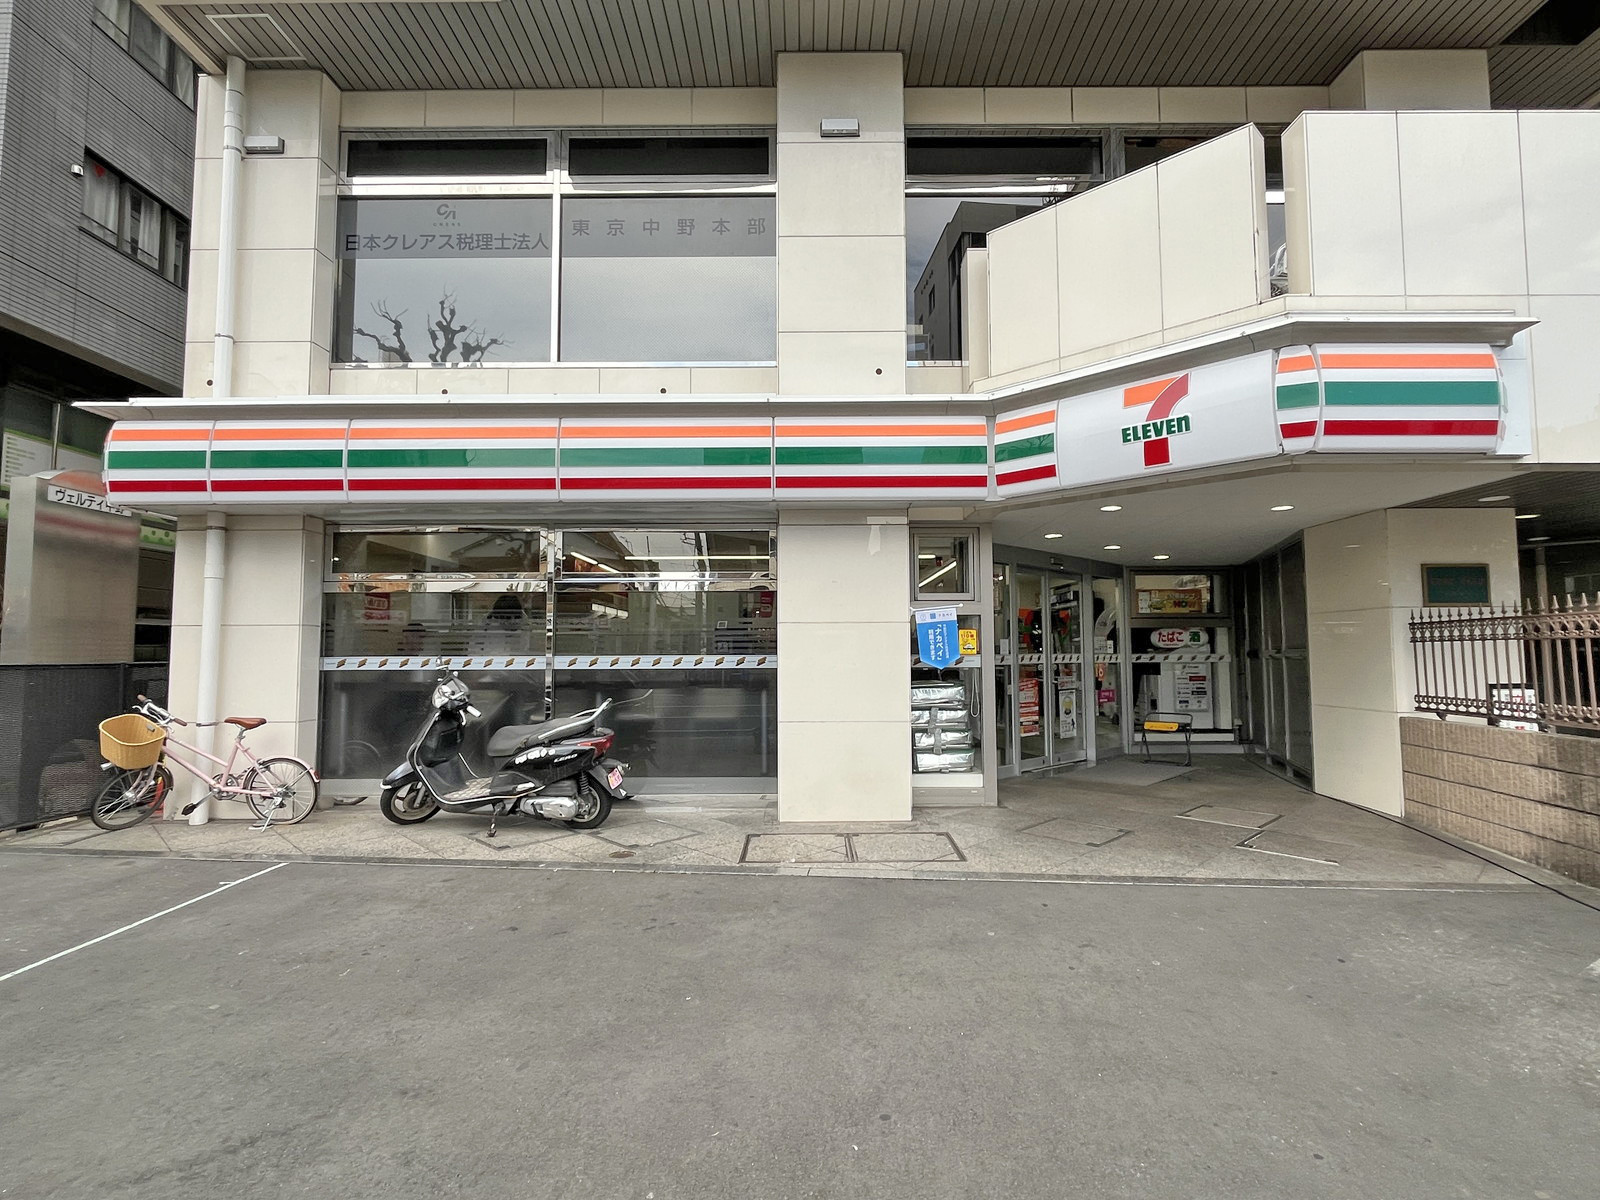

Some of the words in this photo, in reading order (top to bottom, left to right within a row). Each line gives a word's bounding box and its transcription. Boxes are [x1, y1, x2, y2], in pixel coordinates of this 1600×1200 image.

[571, 218, 767, 236] 東京中野本部
[345, 233, 549, 251] 日本クレアス税理士法人
[1124, 372, 1189, 467] 7
[1157, 631, 1184, 643] たばこ
